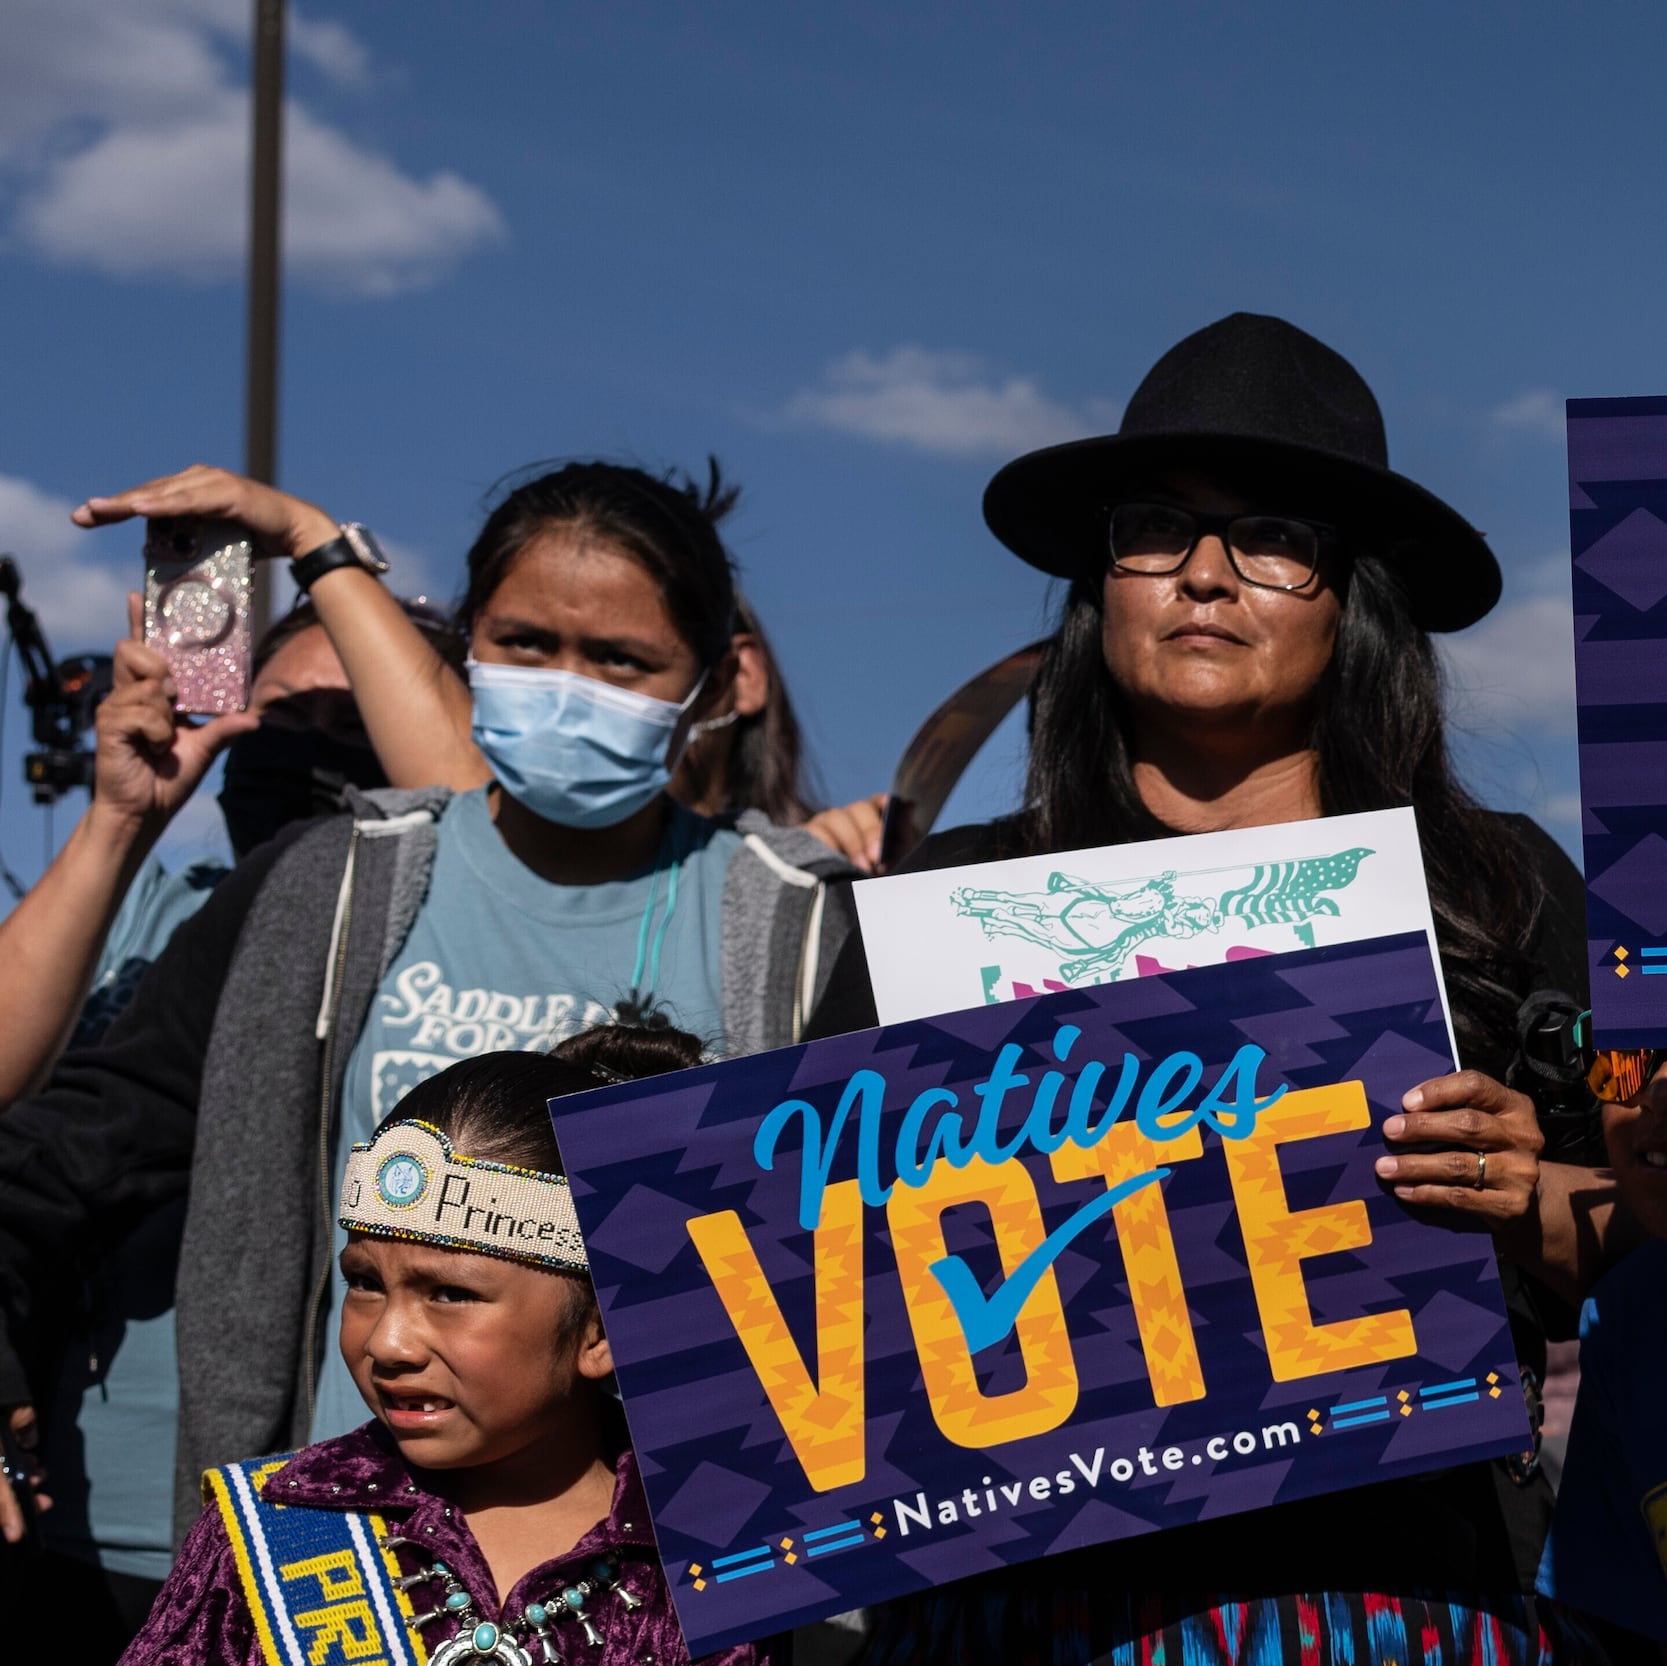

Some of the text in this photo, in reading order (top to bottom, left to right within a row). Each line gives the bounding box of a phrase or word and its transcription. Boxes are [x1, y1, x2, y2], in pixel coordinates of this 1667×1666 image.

[379, 961, 576, 1033] SADDLE
[408, 1014, 516, 1056] FOR
[753, 1024, 1290, 1231] Natives
[435, 1174, 584, 1251] Princess
[686, 1079, 1418, 1493] VOTE
[893, 1420, 1302, 1538] NativesVote.com
